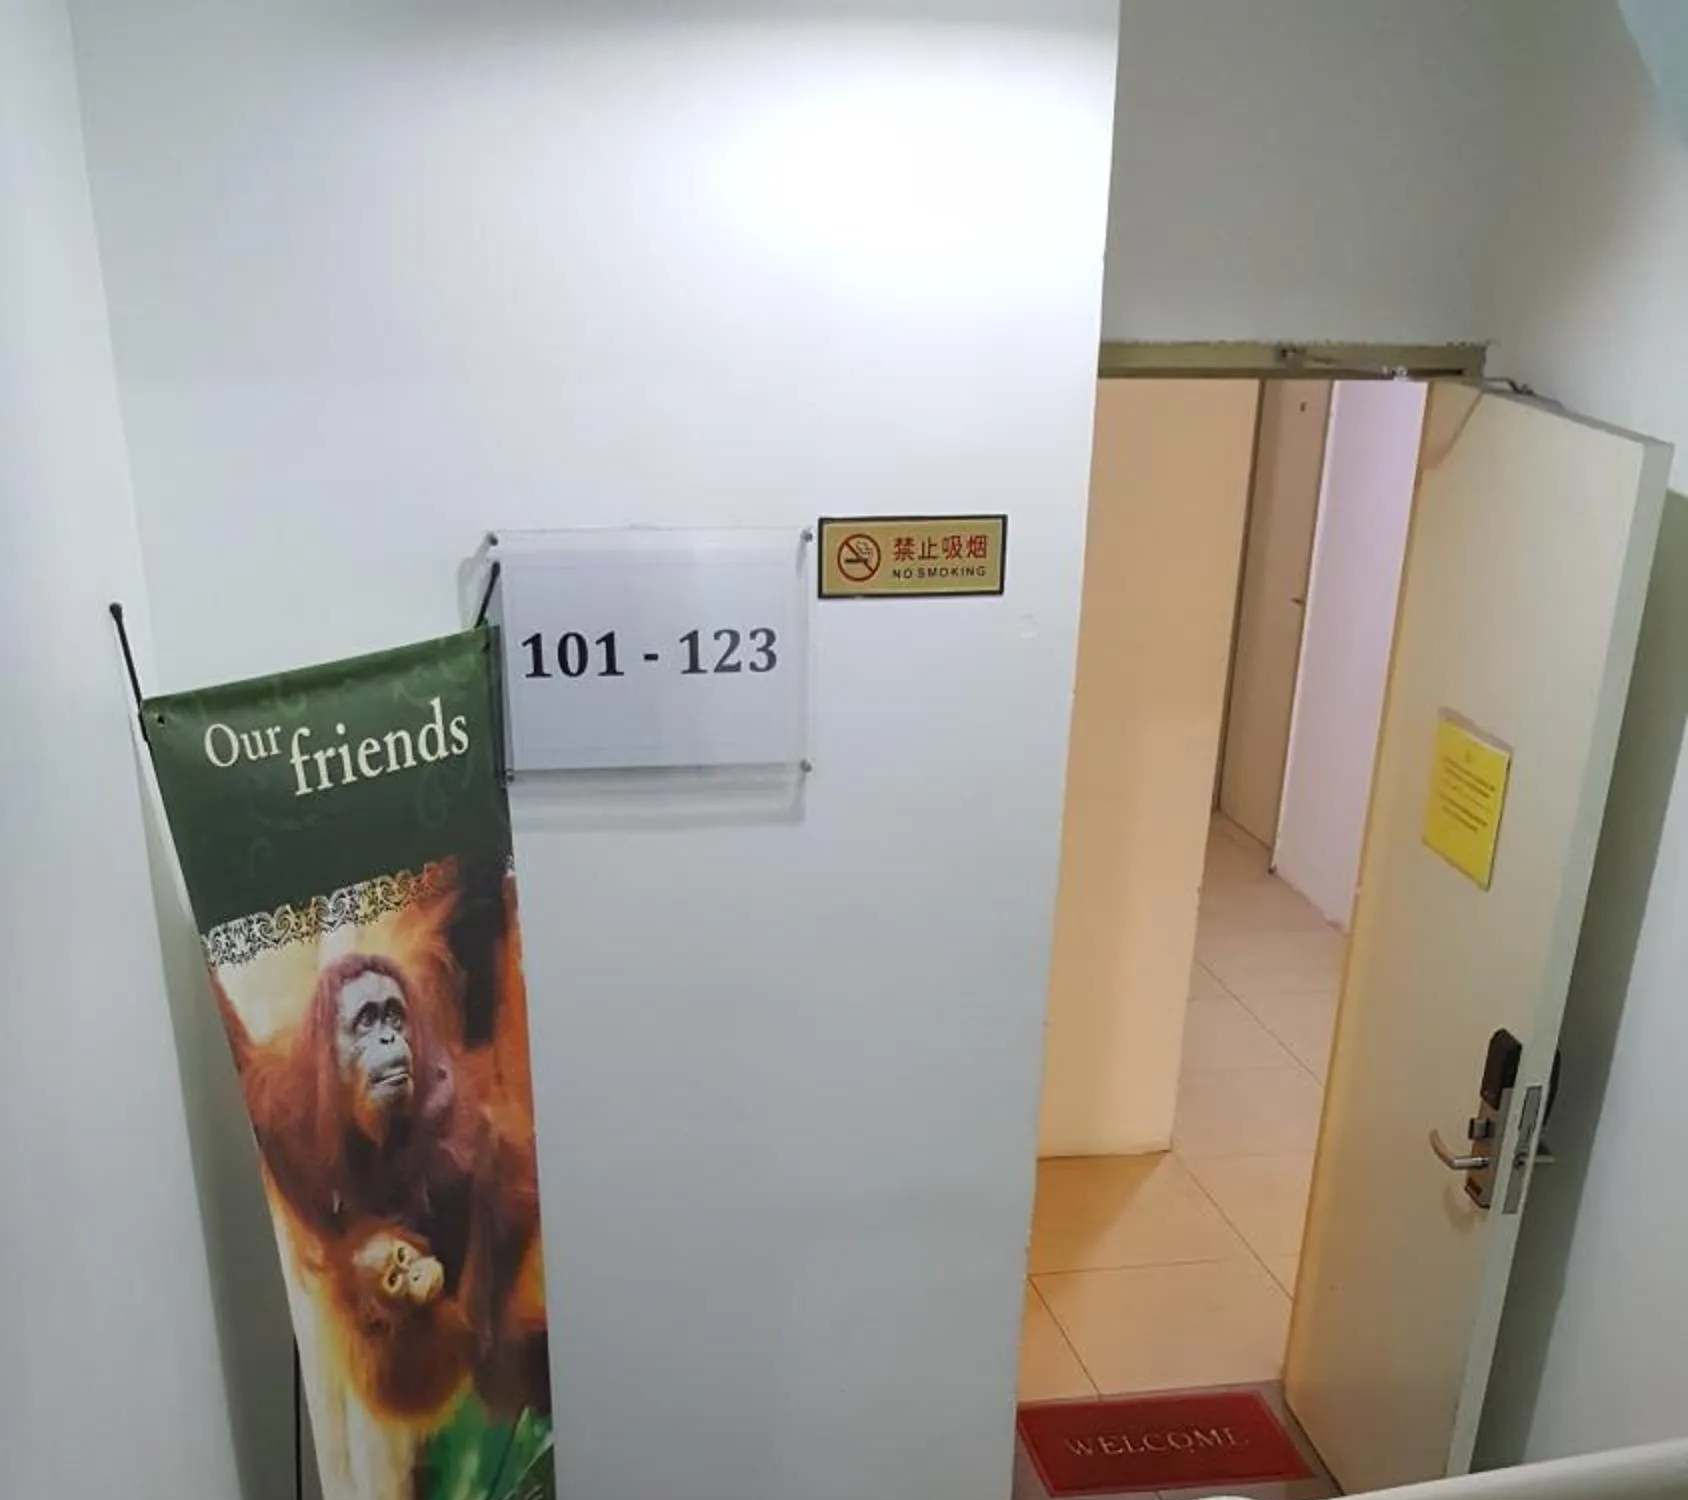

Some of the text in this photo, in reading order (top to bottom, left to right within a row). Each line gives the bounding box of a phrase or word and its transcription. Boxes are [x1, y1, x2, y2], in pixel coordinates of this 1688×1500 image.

[893, 534, 988, 562] 禁止吸烟
[892, 565, 987, 579] NO SMOKING
[521, 627, 778, 678] 101 - 123
[204, 696, 470, 796] Our friends
